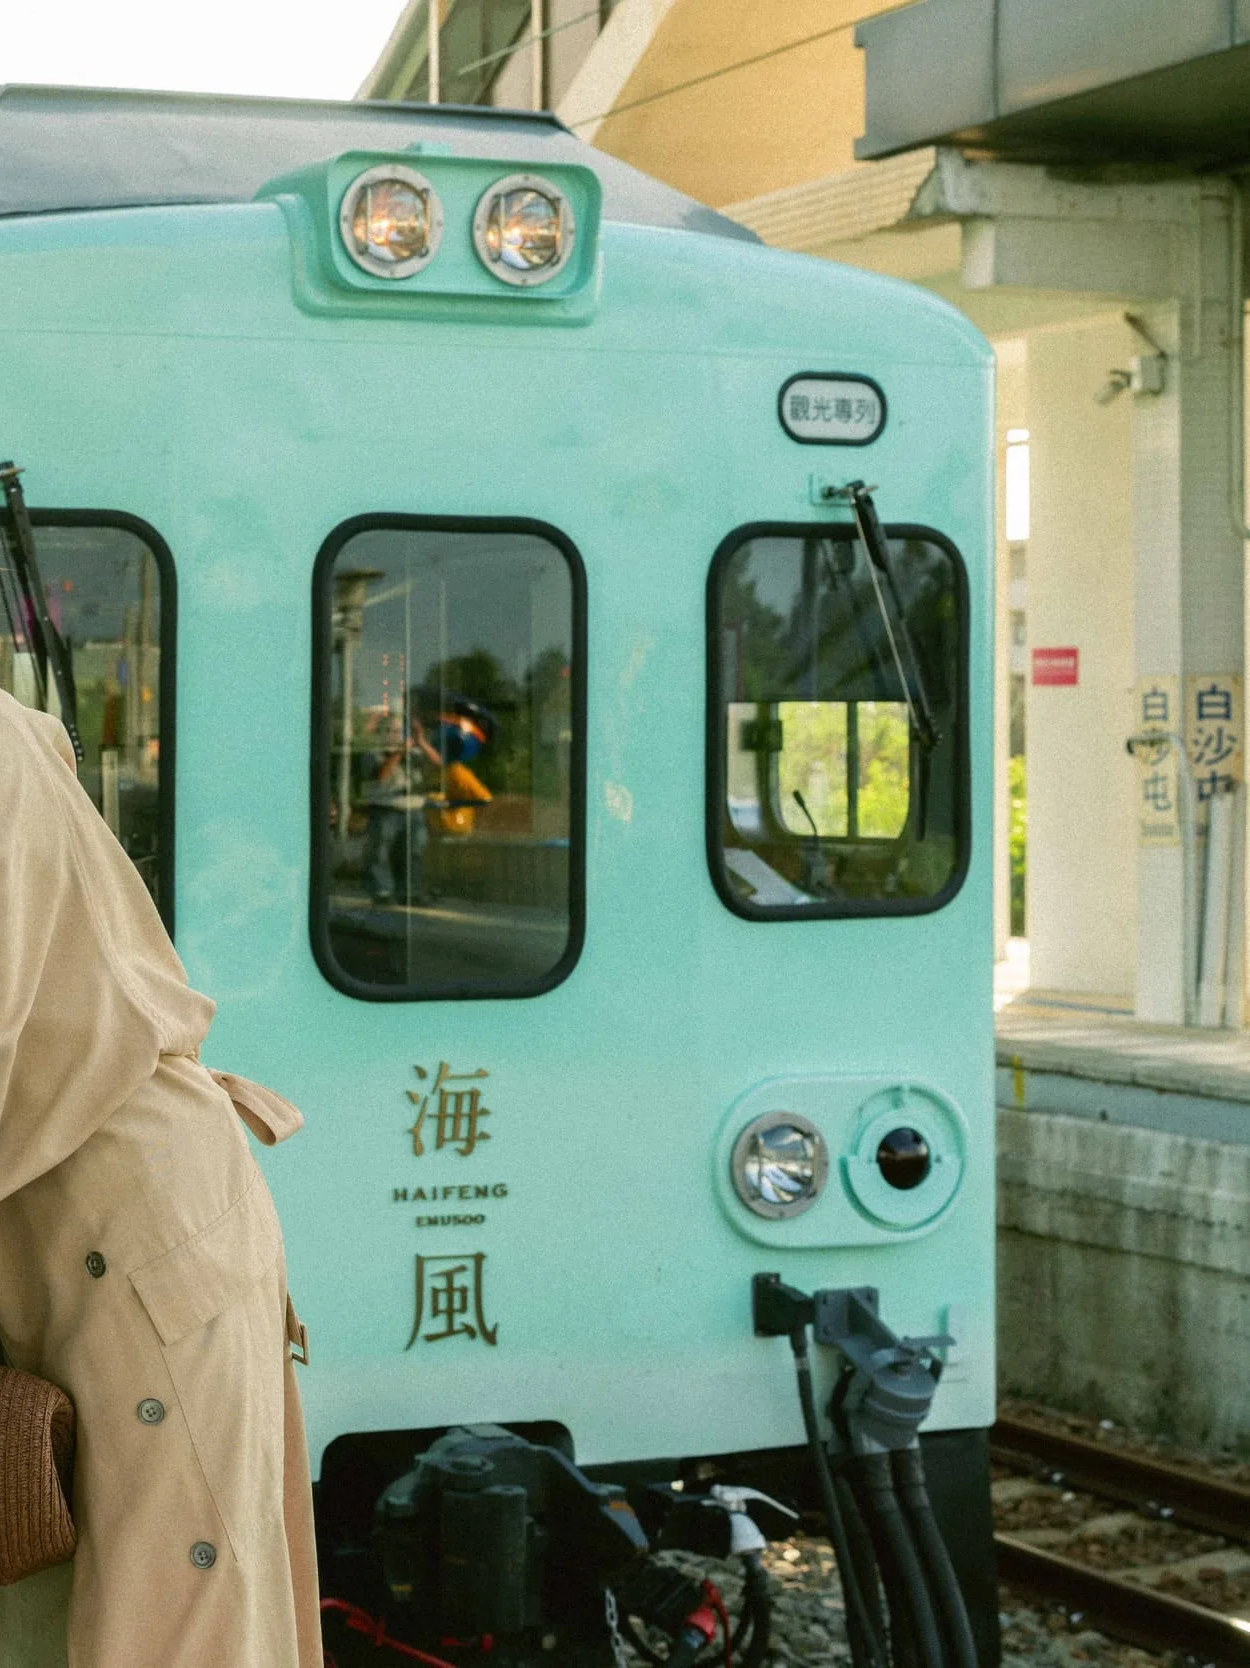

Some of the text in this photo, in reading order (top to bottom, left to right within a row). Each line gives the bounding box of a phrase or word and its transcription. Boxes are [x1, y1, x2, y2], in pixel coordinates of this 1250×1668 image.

[790, 395, 876, 424] 觀光專列
[392, 1183, 508, 1202] HAIFENG
[415, 1213, 486, 1228] EMU500
